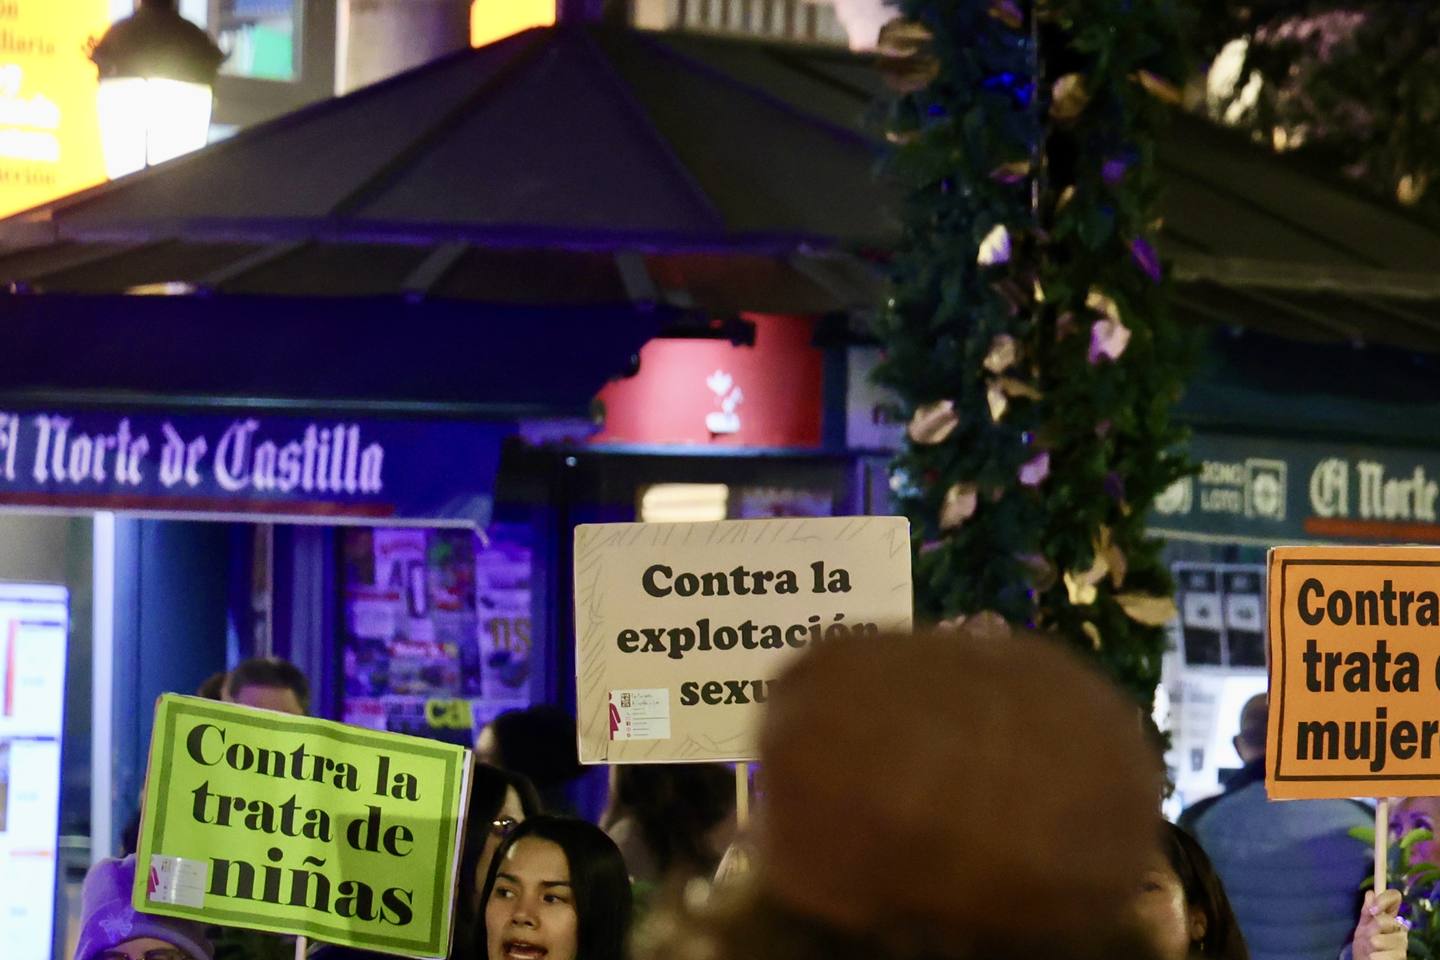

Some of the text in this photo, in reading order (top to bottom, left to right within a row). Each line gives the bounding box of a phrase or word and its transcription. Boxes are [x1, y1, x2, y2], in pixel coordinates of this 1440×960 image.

[34, 414, 150, 484] Norte
[159, 421, 208, 487] de
[214, 419, 384, 493] Castilla
[1310, 458, 1348, 518] El
[1356, 459, 1438, 521] Norte
[642, 561, 852, 597] Contra la
[1297, 578, 1440, 626] Contra
[617, 613, 880, 659] explotación
[680, 679, 783, 706] sexu
[1303, 640, 1420, 692] trata
[186, 724, 420, 802] Contra la
[192, 780, 414, 857] trata de
[205, 847, 414, 926] niñas
